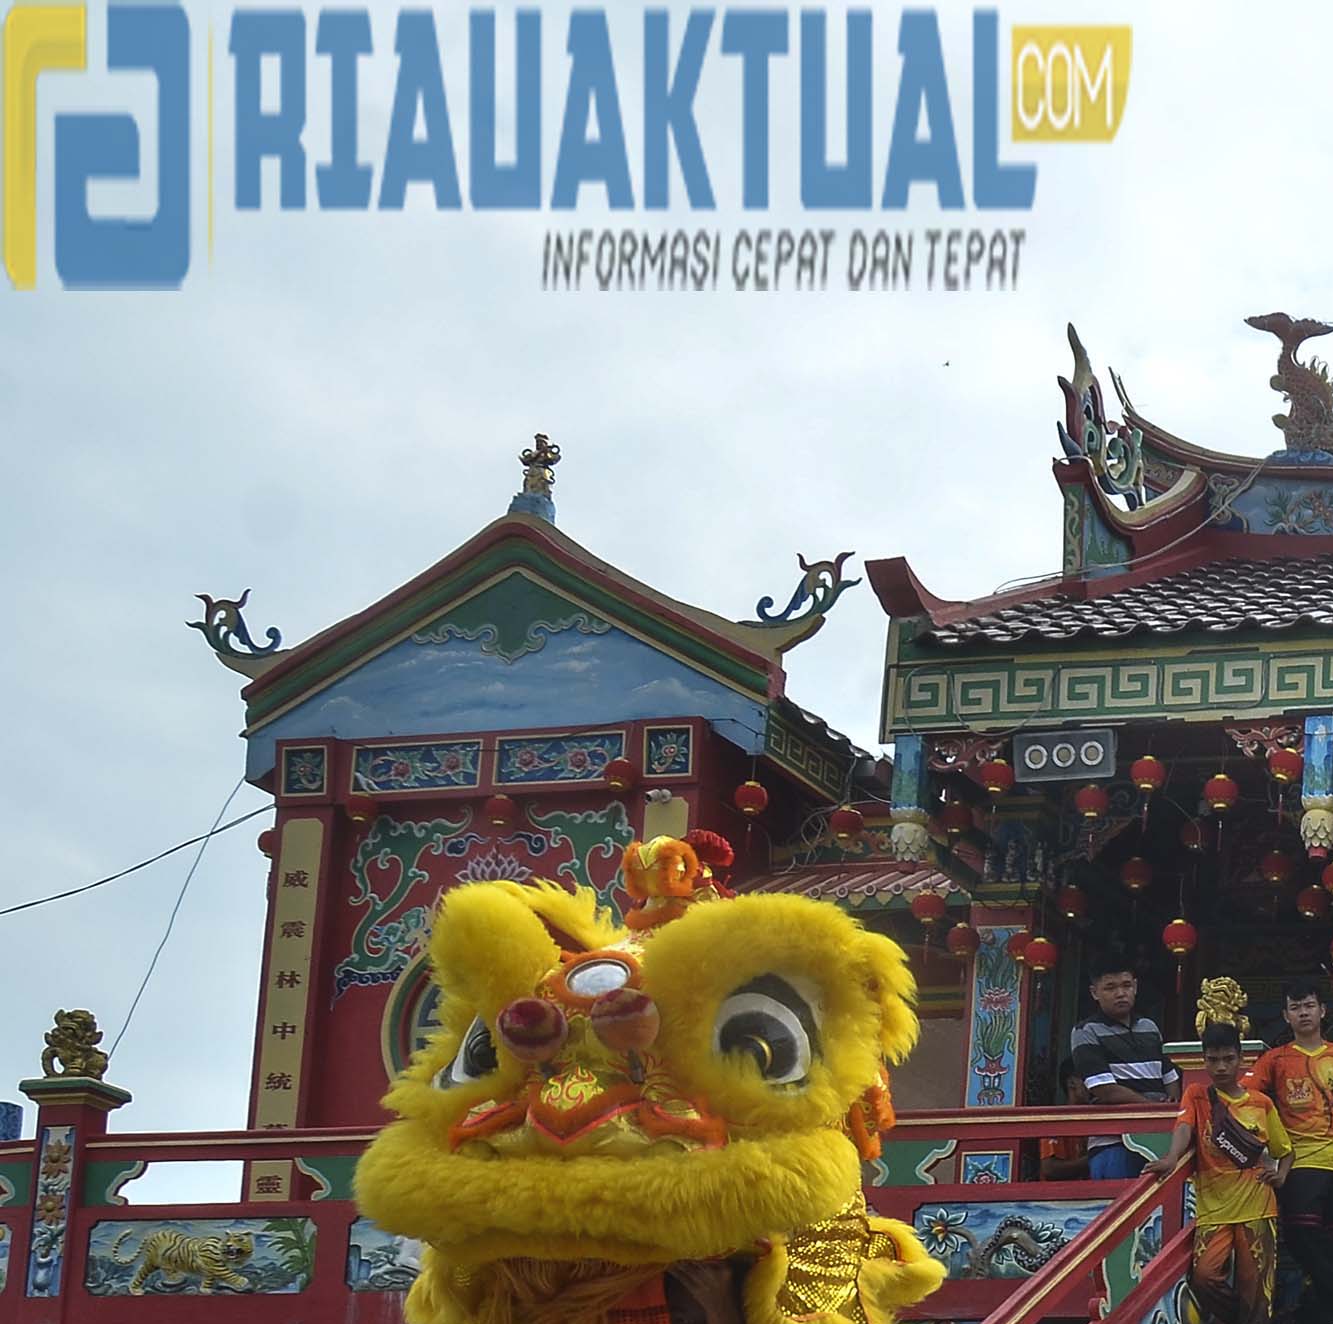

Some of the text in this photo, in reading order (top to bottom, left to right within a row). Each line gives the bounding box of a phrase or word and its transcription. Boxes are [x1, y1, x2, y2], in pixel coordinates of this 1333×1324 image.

[254, 869, 309, 1195] 威震林中統靈
